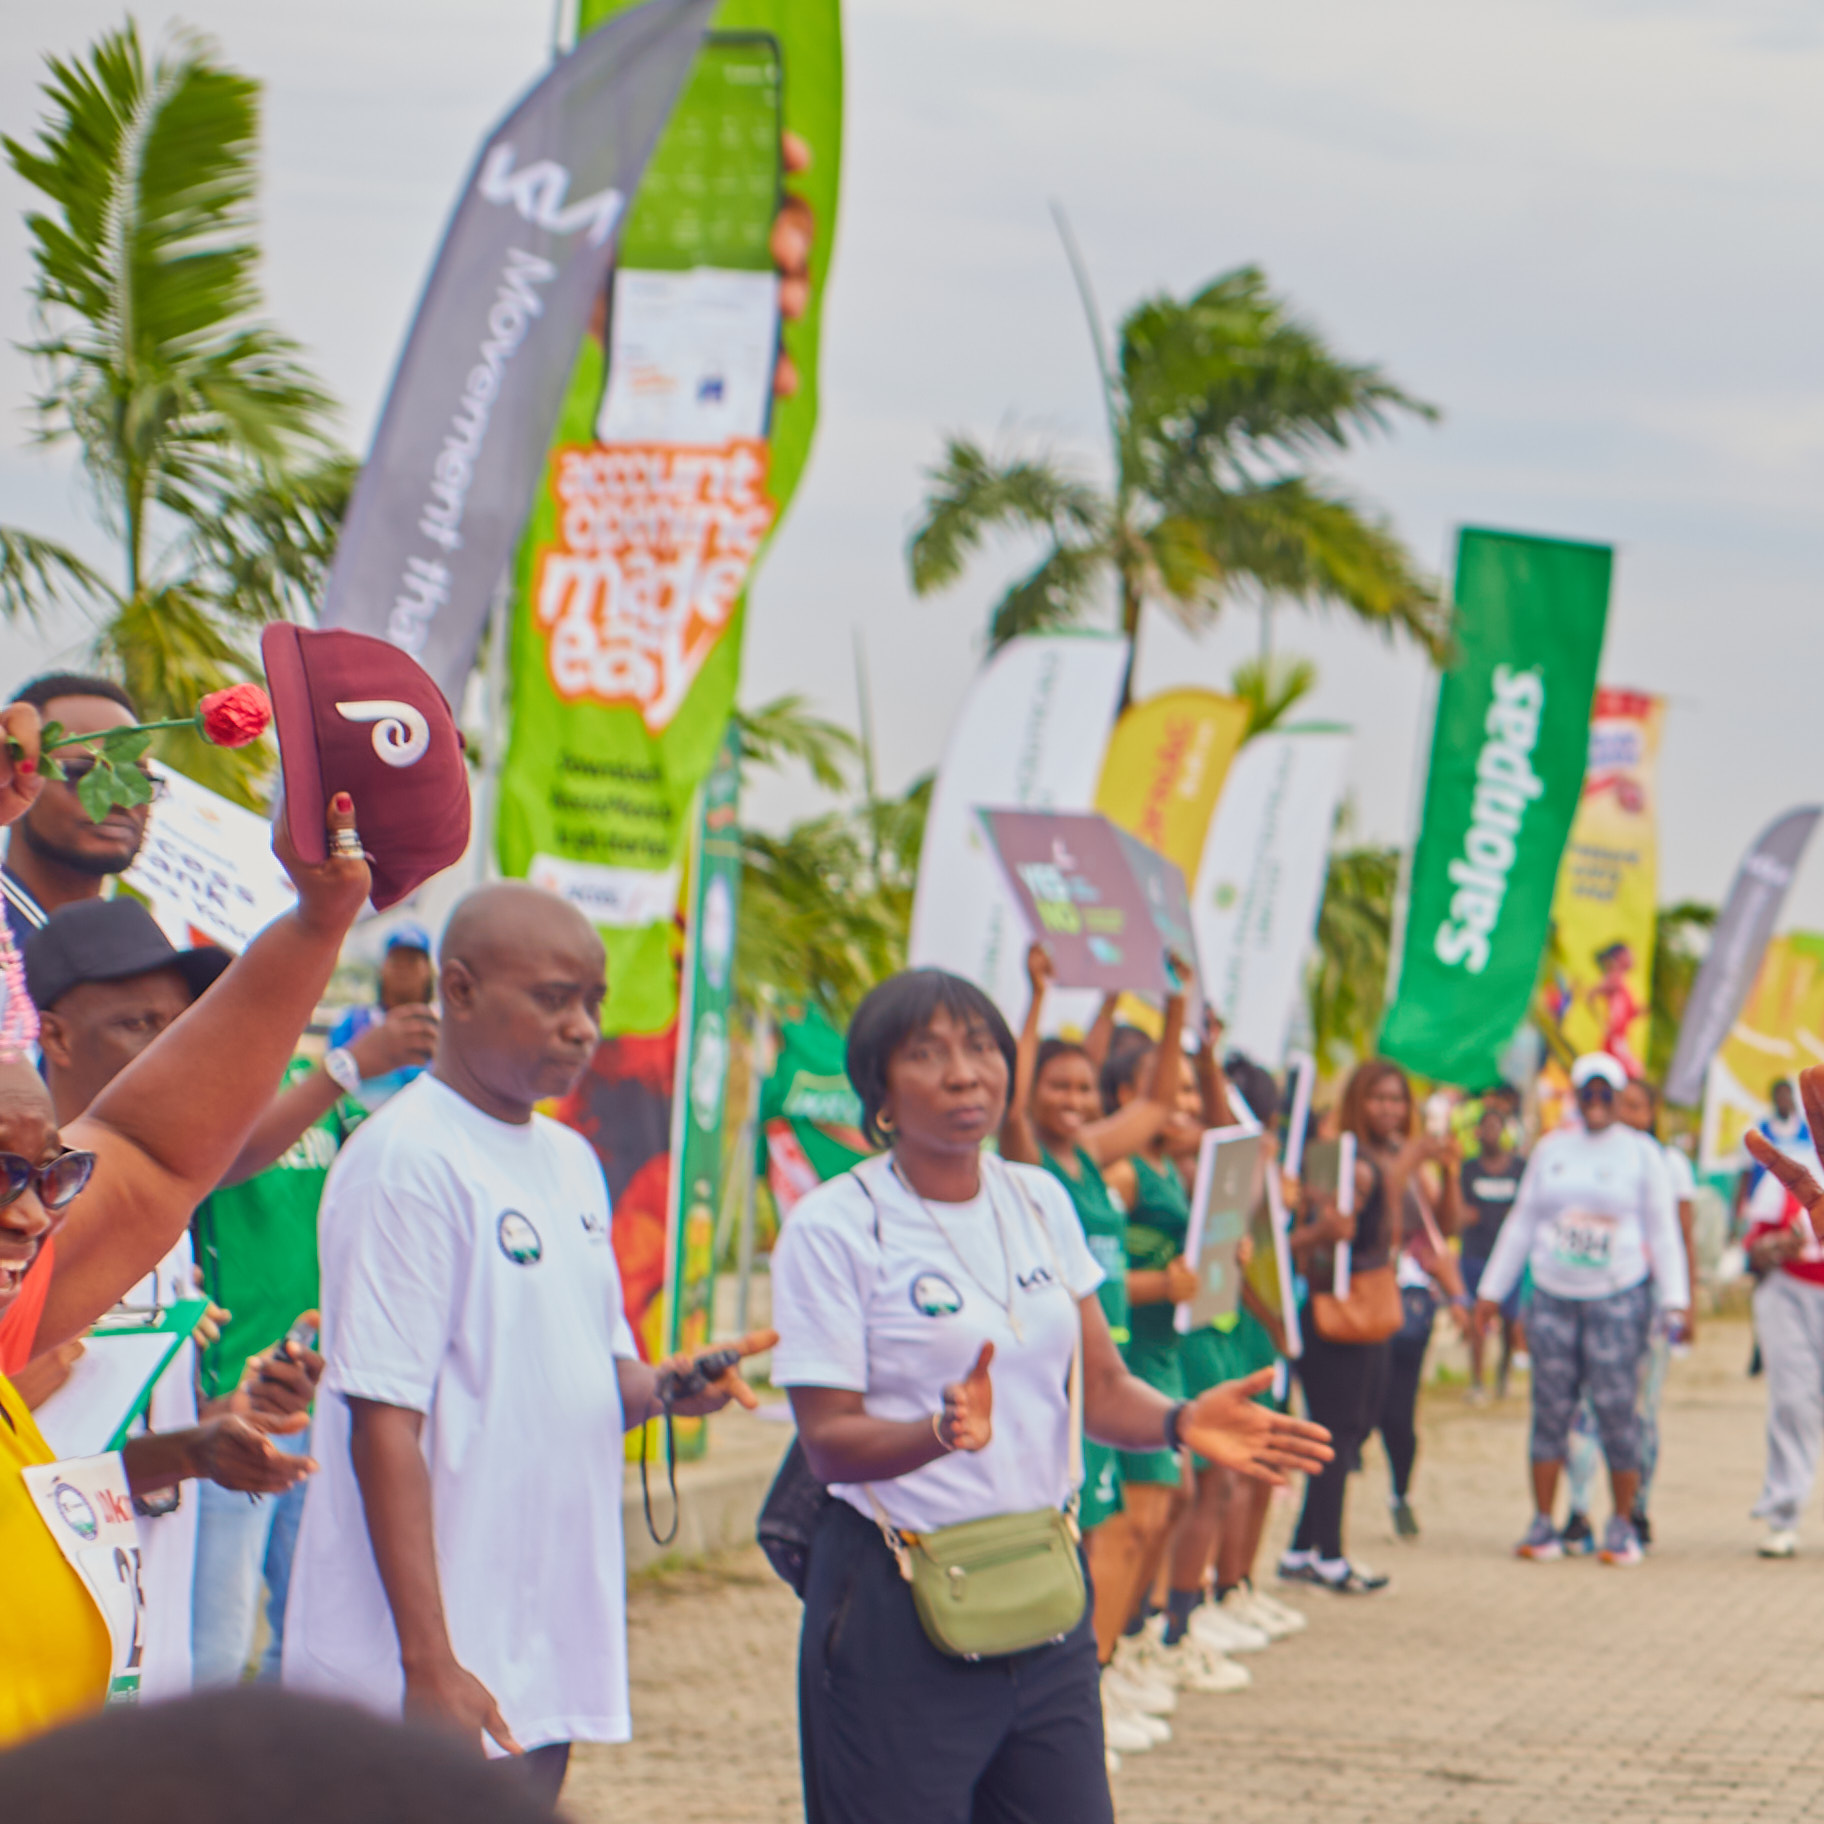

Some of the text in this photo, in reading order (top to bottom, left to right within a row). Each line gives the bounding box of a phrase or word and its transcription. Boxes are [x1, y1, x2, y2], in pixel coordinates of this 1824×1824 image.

[388, 247, 556, 655] Movement tha
[539, 546, 744, 624] made
[552, 612, 694, 728] easy
[335, 700, 431, 768] P
[1435, 662, 1544, 974] Salonpas
